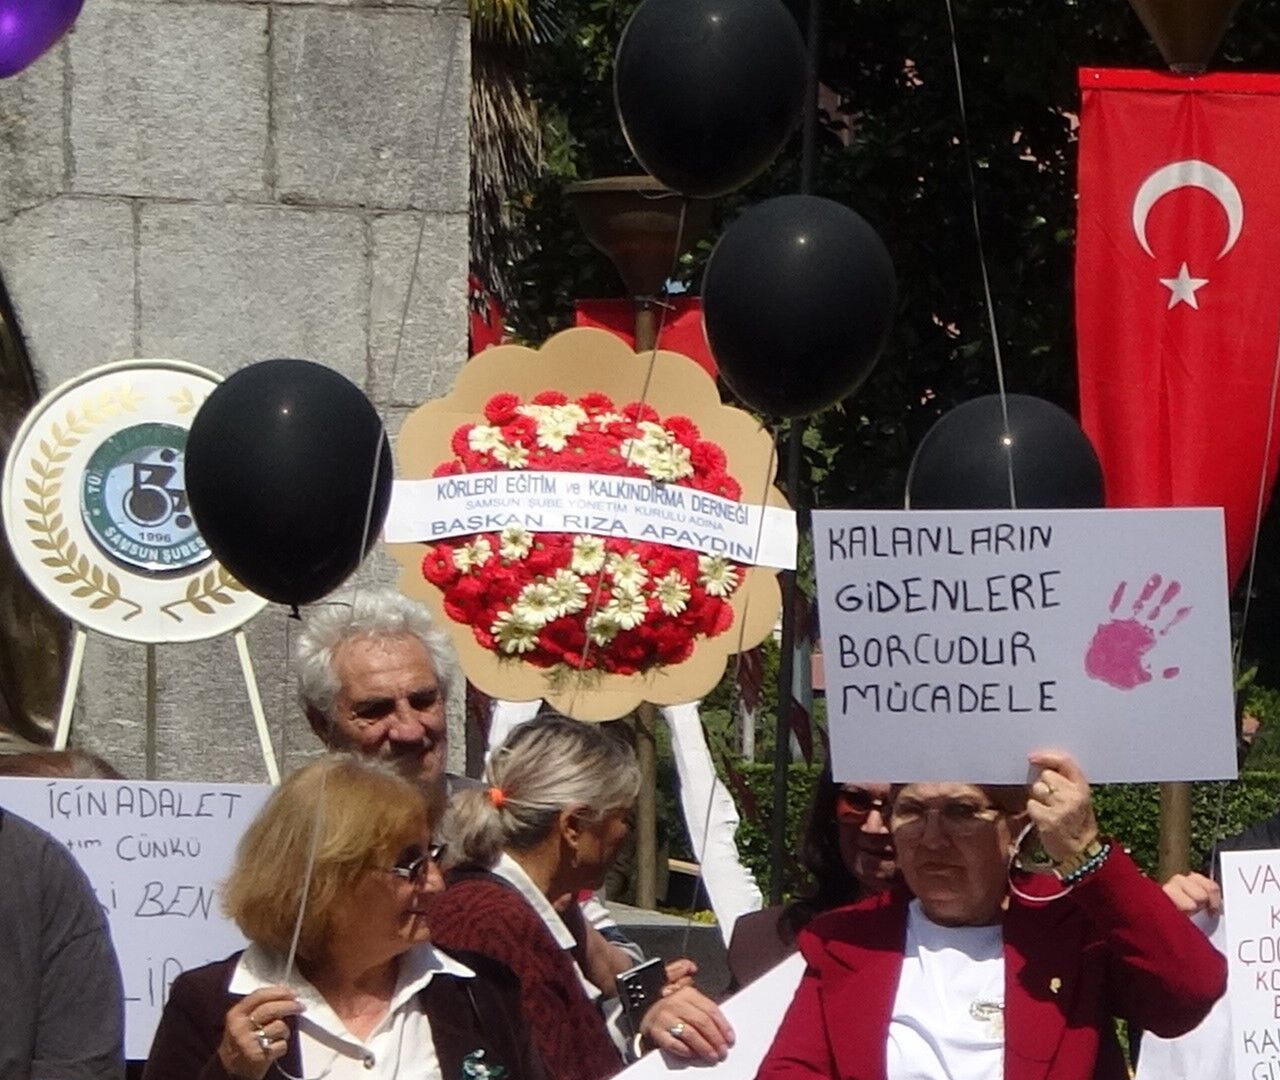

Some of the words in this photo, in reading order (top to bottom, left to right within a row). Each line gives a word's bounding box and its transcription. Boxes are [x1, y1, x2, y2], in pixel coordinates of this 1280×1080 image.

[437, 475, 498, 500] KÖRLERİ
[506, 473, 556, 494] EĞİTİM
[691, 494, 749, 525] DERNEĞİ
[466, 498, 520, 511] SAMSUN
[528, 498, 563, 509] ŞUBE
[635, 506, 686, 522] KURULU
[104, 526, 159, 560] SAMSUN
[162, 536, 207, 563] ŞUBES
[138, 531, 173, 543] 1996
[431, 514, 543, 535] BAŞKAN
[563, 514, 629, 534] RIZA
[641, 523, 753, 560] APAYDIN
[829, 524, 1053, 560] KALANLARIN
[836, 570, 1061, 613] GİDENLERE
[839, 631, 1036, 668] BORCUDUR
[842, 680, 1058, 714] MÜCADELE
[116, 786, 242, 819] ADALET
[135, 881, 215, 920] BEN
